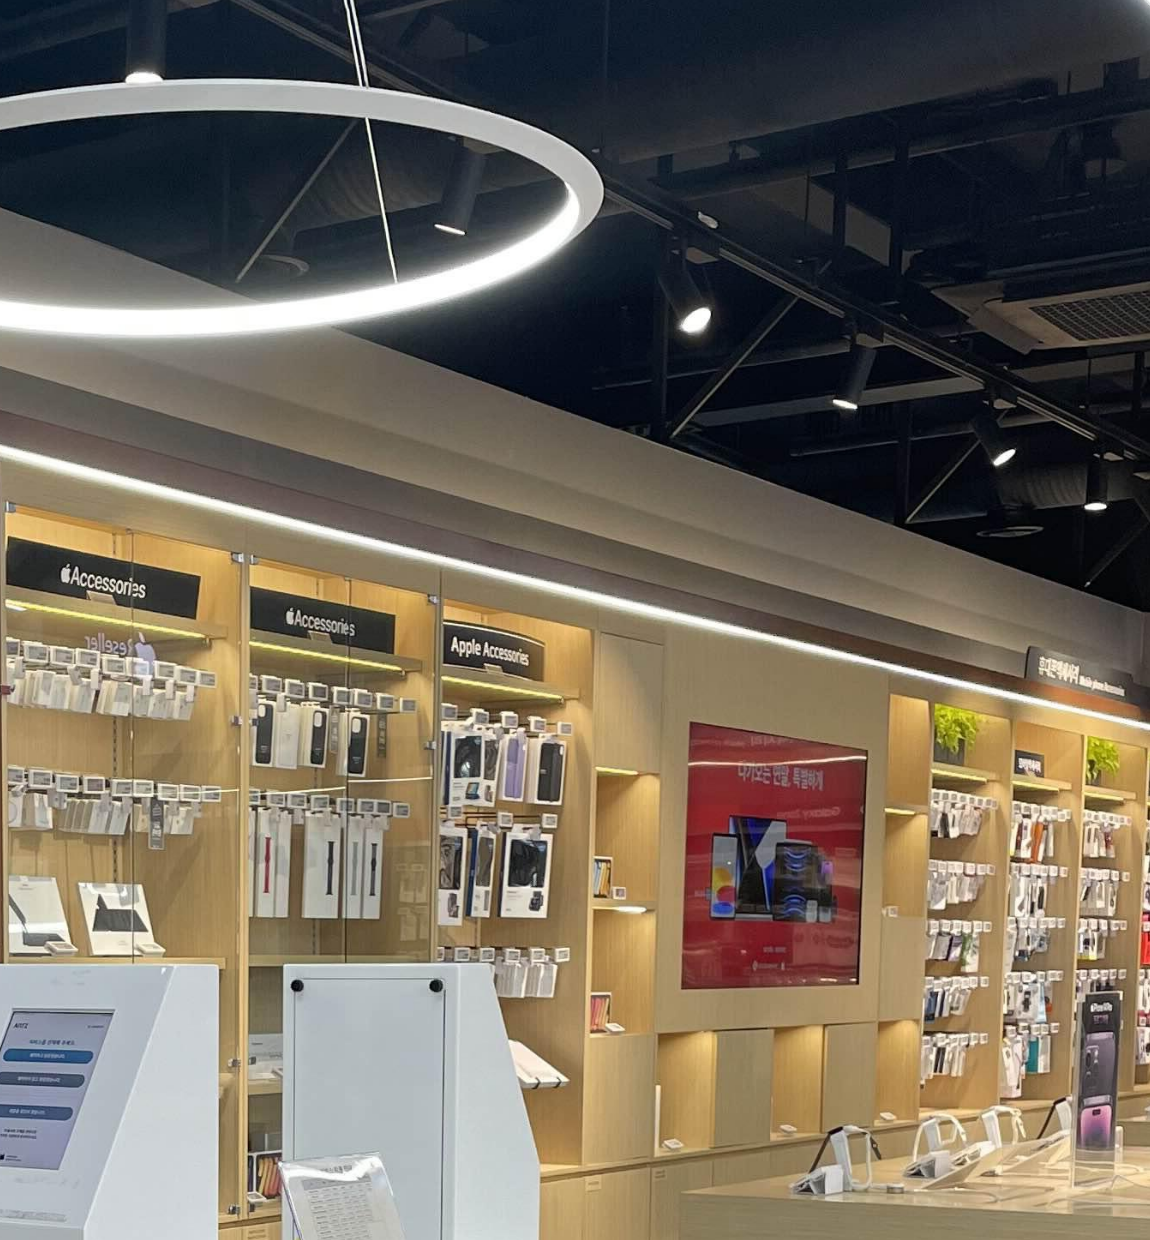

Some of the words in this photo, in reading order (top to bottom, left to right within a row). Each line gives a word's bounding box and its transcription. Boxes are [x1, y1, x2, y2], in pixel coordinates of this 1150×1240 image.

[70, 565, 147, 599] Accessories
[294, 609, 356, 637] Accessories
[450, 636, 482, 658] Apple
[482, 641, 530, 667] Accessories
